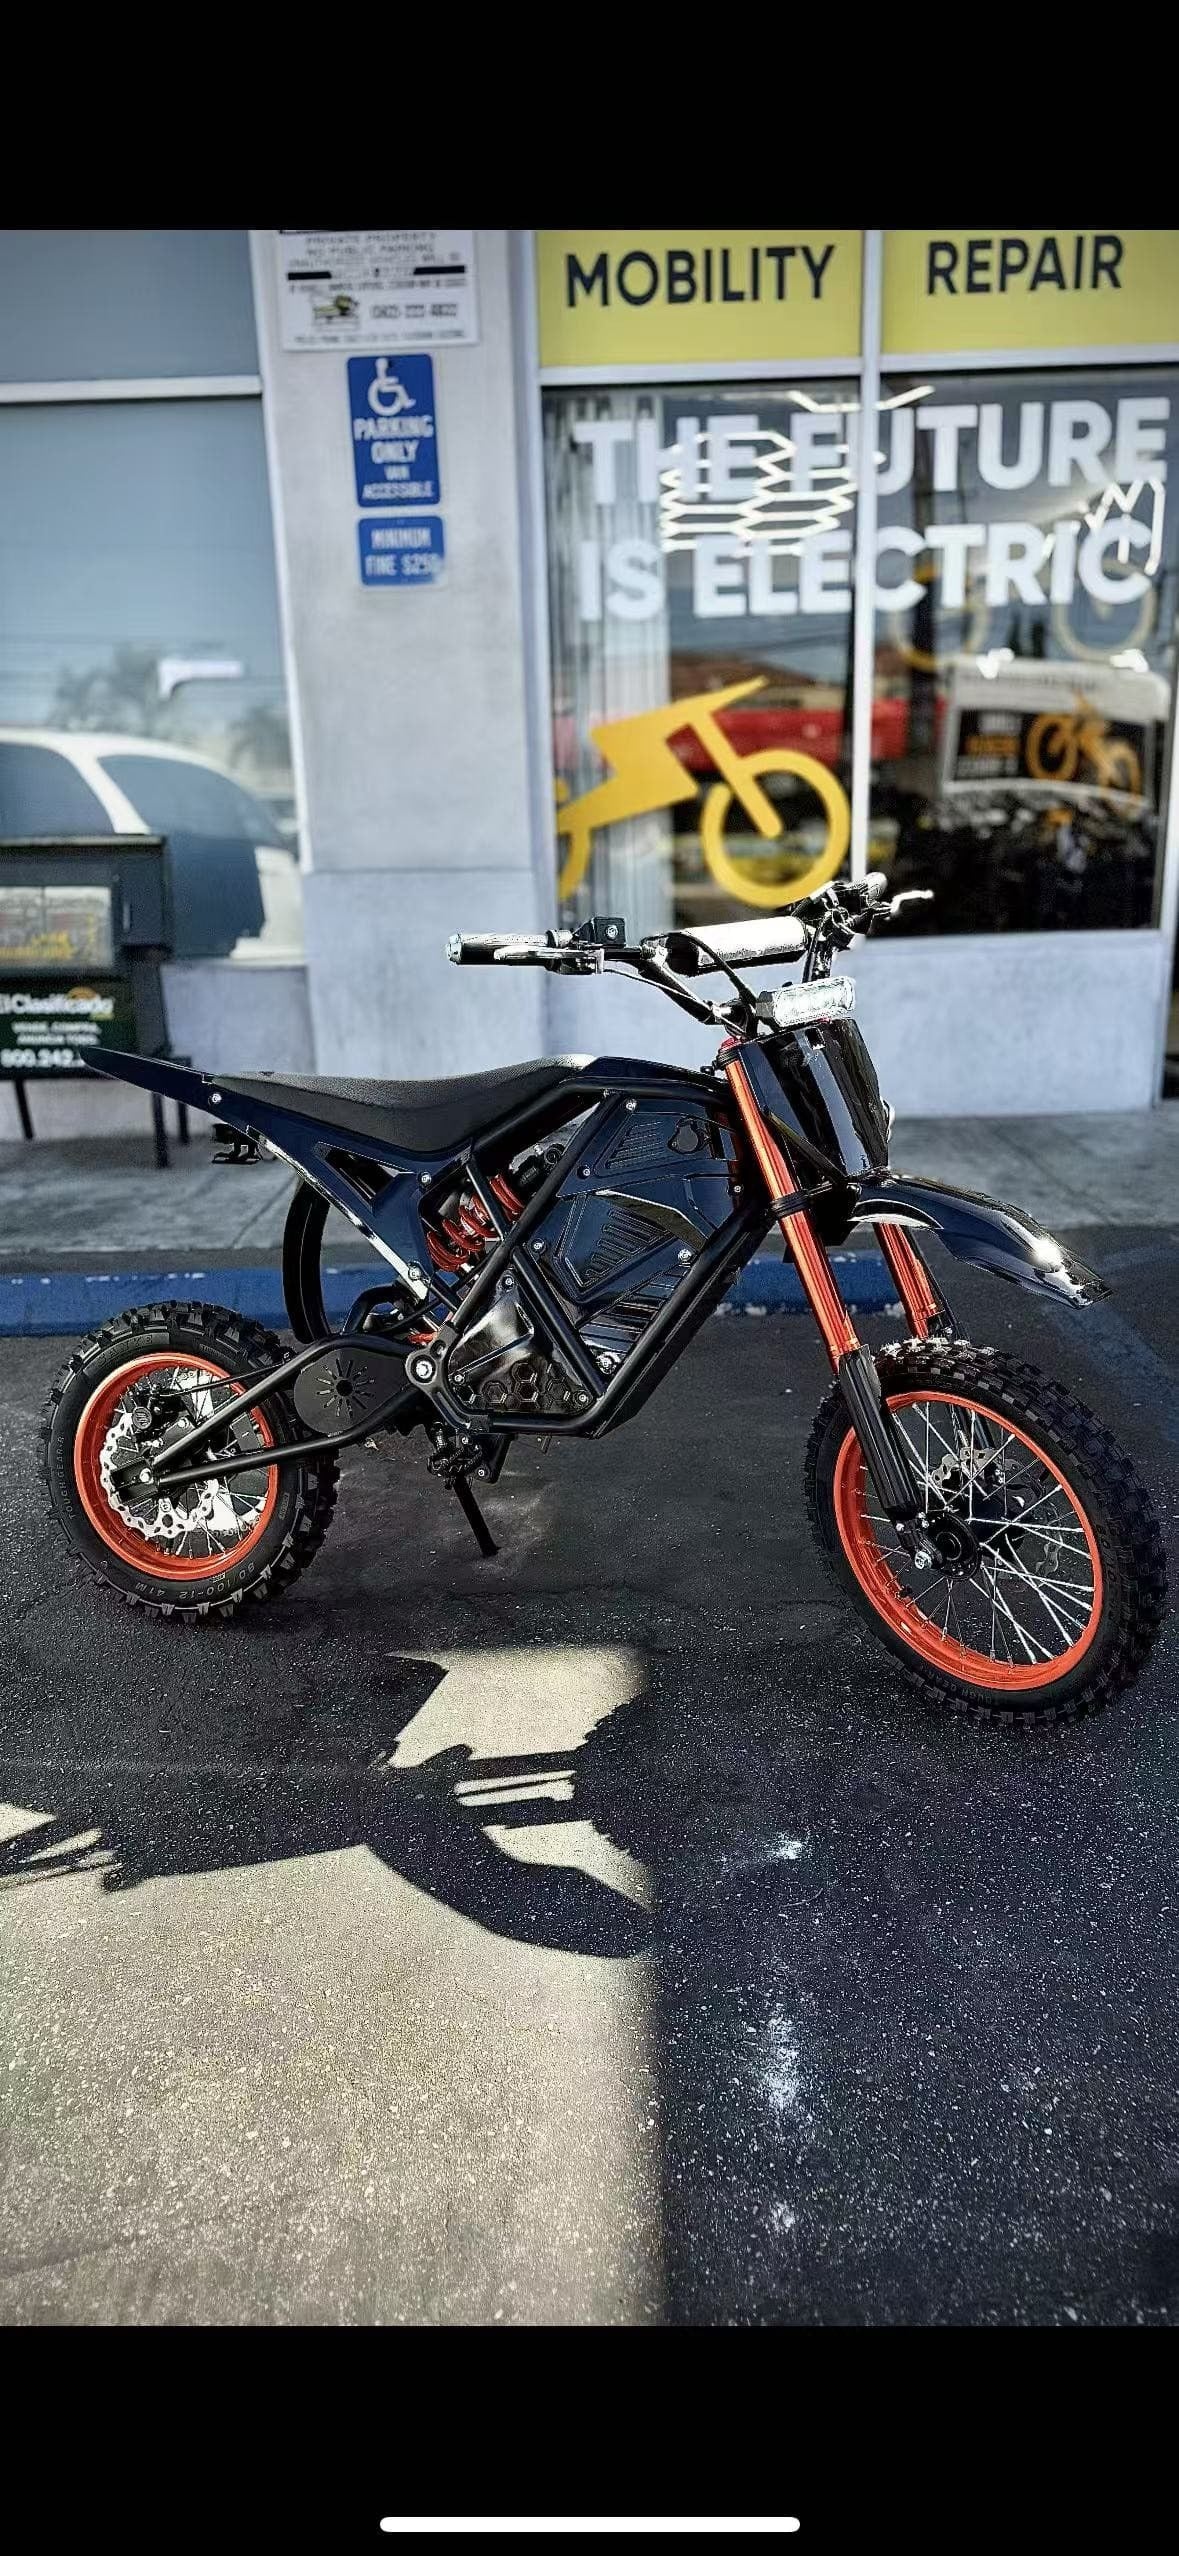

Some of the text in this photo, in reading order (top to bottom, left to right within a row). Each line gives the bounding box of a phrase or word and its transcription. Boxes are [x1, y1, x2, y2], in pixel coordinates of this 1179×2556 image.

[565, 234, 1124, 308] MOBILITY REPAIR
[354, 416, 433, 440] PARKING
[372, 441, 418, 463] ONLY
[574, 396, 1171, 503] THE FUTURE
[370, 526, 432, 549] MINIMUM
[365, 554, 398, 576] FINE
[578, 518, 1154, 621] IS ELECTRIC
